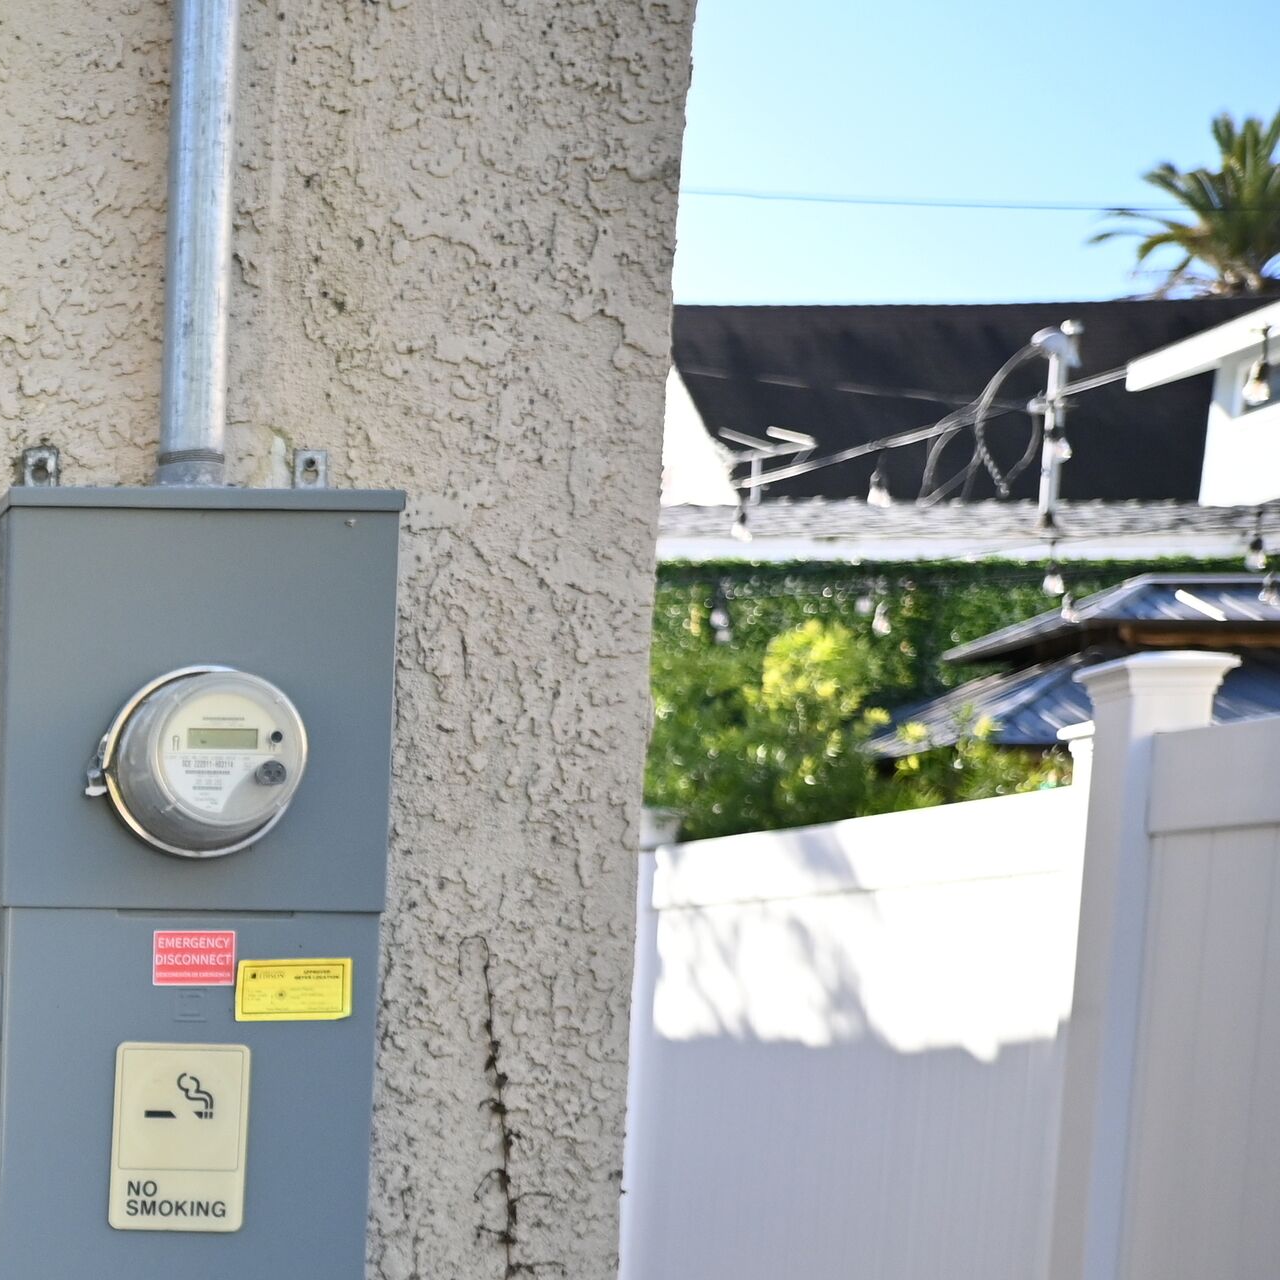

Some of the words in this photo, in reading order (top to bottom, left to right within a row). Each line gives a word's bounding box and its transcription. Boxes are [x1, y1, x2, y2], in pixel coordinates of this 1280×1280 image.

[157, 937, 230, 949] EMERGENCY
[155, 953, 232, 966] DISCONNECT
[127, 1180, 158, 1198] NO
[126, 1199, 227, 1218] SMOKING
